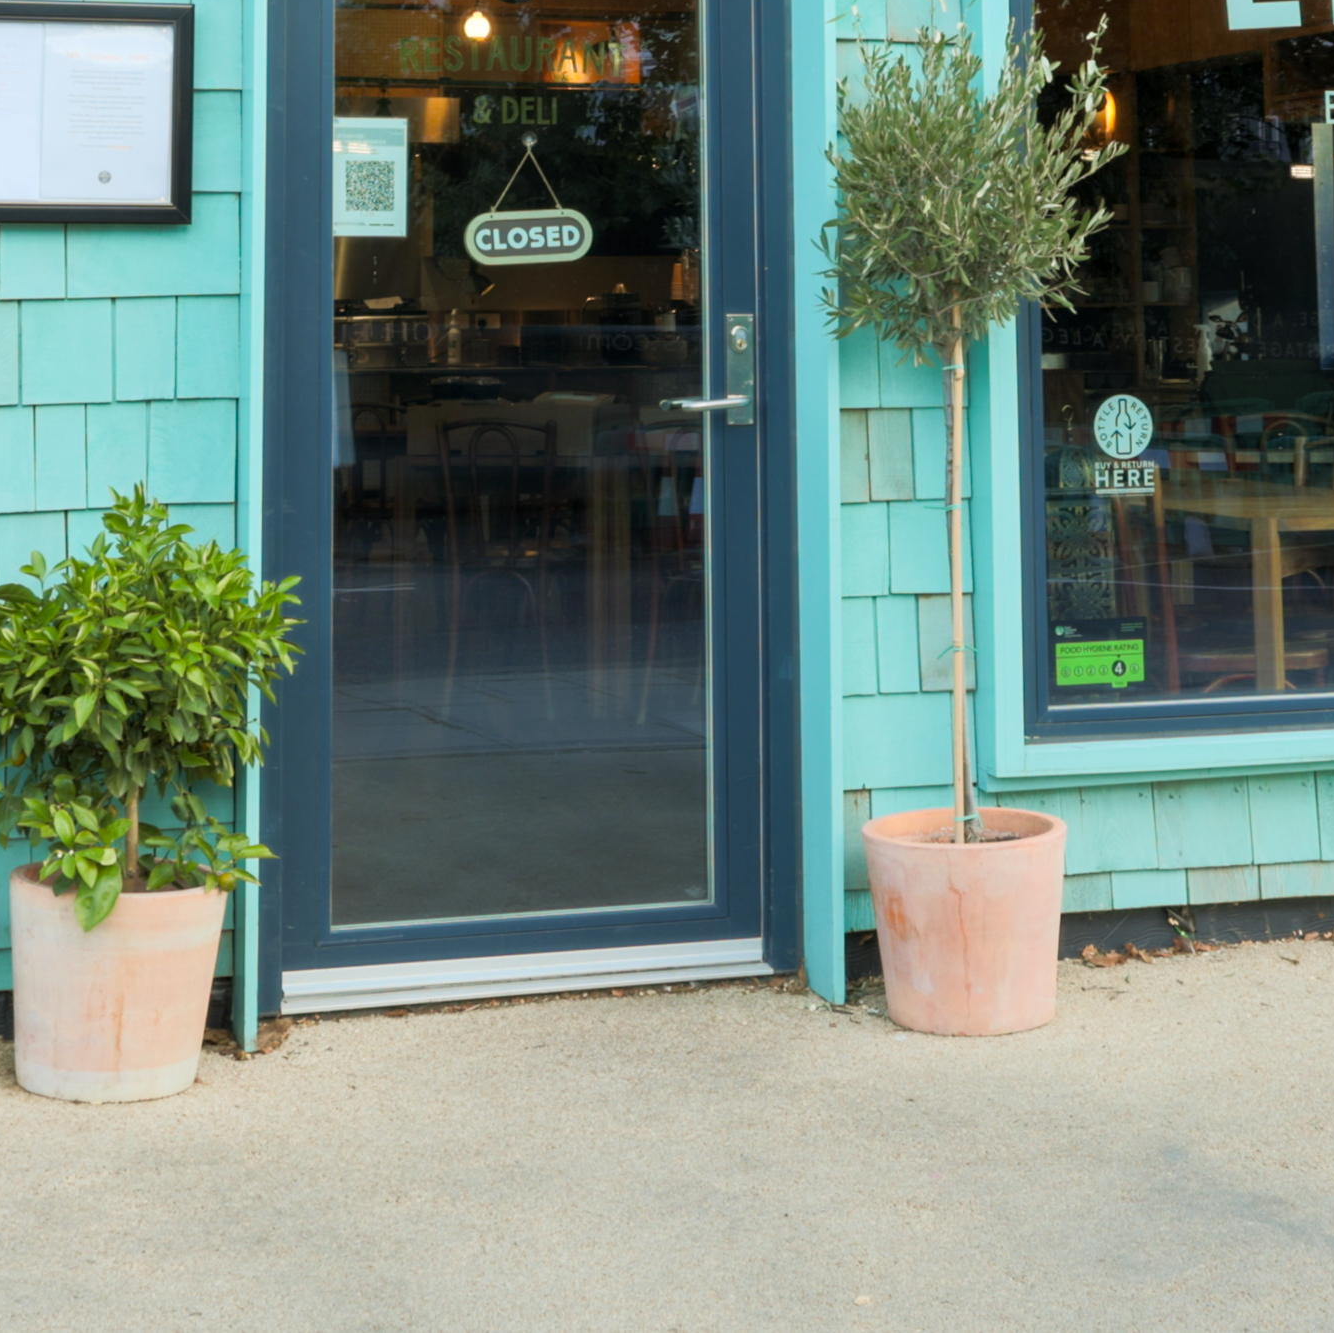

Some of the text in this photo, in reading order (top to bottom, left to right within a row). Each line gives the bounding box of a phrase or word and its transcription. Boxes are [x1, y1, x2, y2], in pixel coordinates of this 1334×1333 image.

[398, 34, 627, 78] RESTAURANT
[472, 95, 558, 126] & DELI
[475, 224, 581, 251] CLOSED
[1098, 401, 1149, 449] BOTTLE RETURN
[1094, 461, 1112, 470] BUY
[1121, 460, 1154, 469] RETURN
[1095, 469, 1155, 487] HERE
[1060, 646, 1082, 654] FOOD
[1114, 643, 1139, 651] RATING
[1114, 661, 1123, 674] 4
